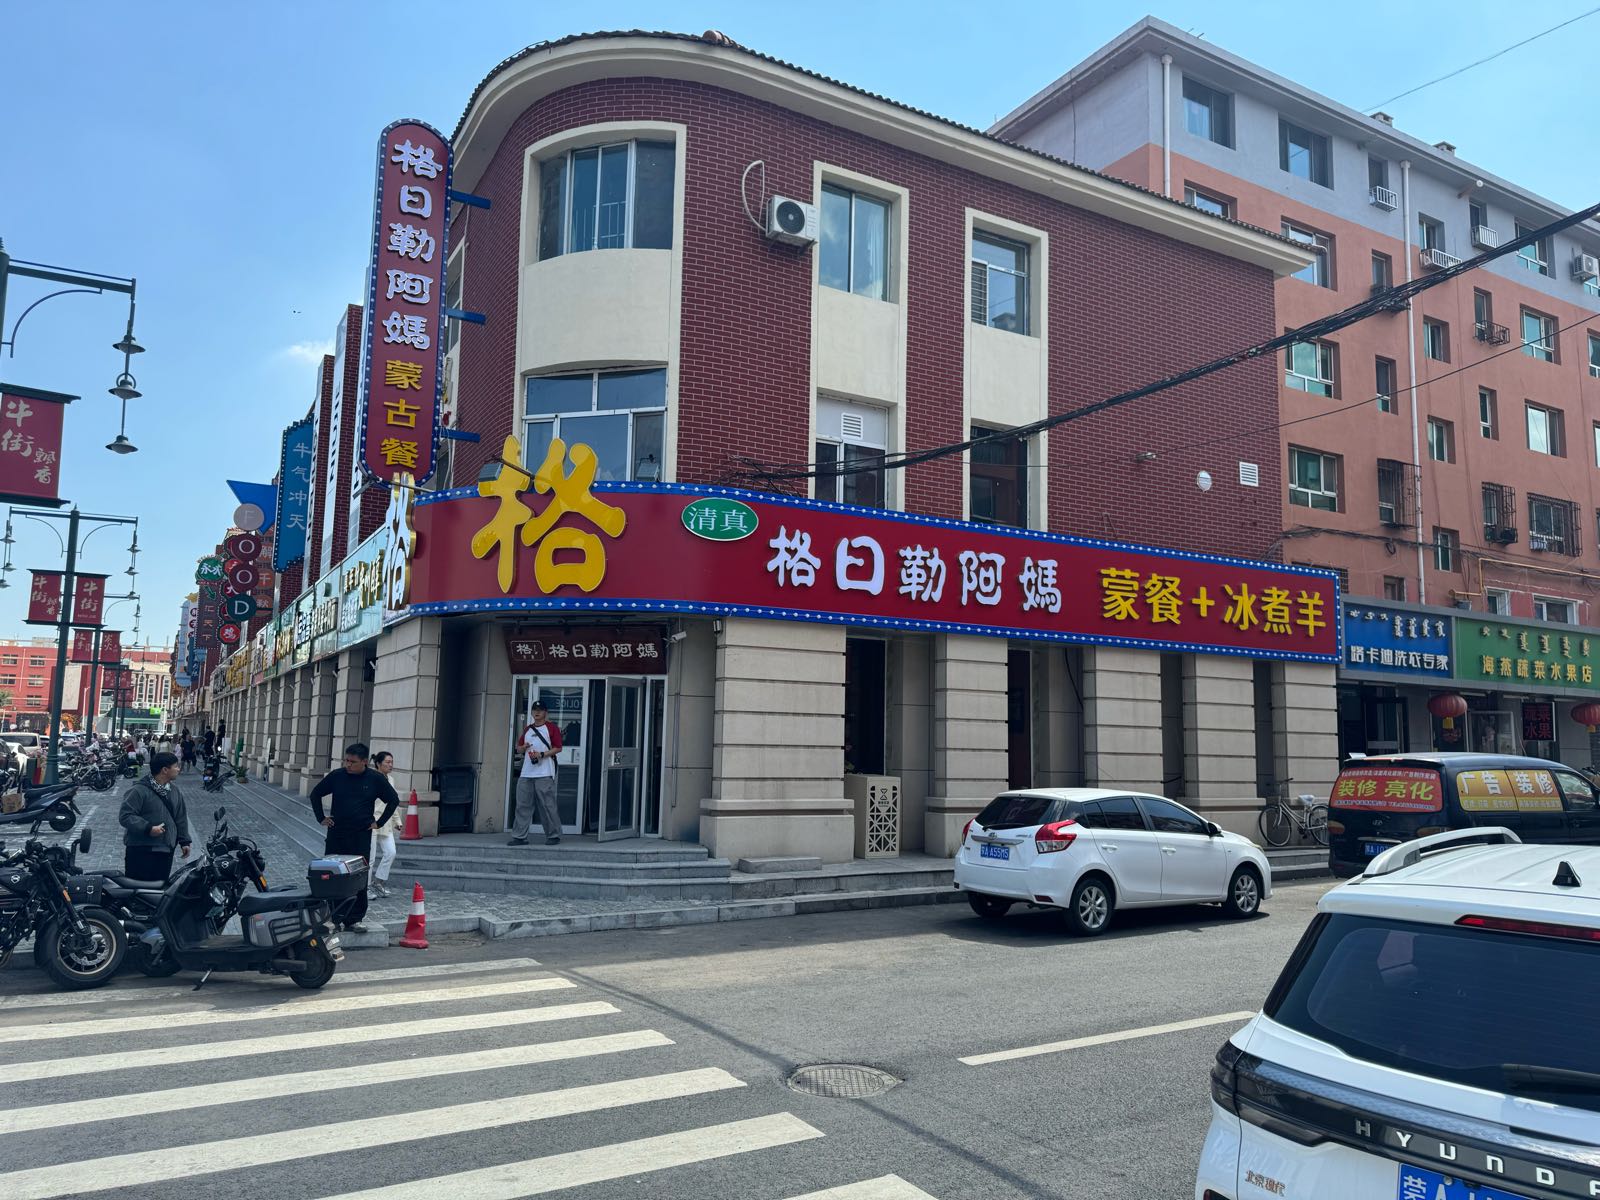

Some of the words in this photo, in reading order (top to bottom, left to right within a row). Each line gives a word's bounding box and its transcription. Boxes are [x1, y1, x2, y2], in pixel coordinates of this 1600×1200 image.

[286, 442, 312, 530] 牛气冲天
[472, 435, 626, 594] 格
[688, 506, 749, 534] 清真
[767, 524, 1063, 614] 格日勒阿媽
[1100, 567, 1328, 637] 蒙餐+冰煮羊
[548, 642, 659, 659] 格日勒阿媽
[1350, 644, 1449, 671] 路卡迪洗衣专家
[1481, 654, 1593, 684] 海燕蔬菜水果店
[1524, 722, 1552, 739] 水果
